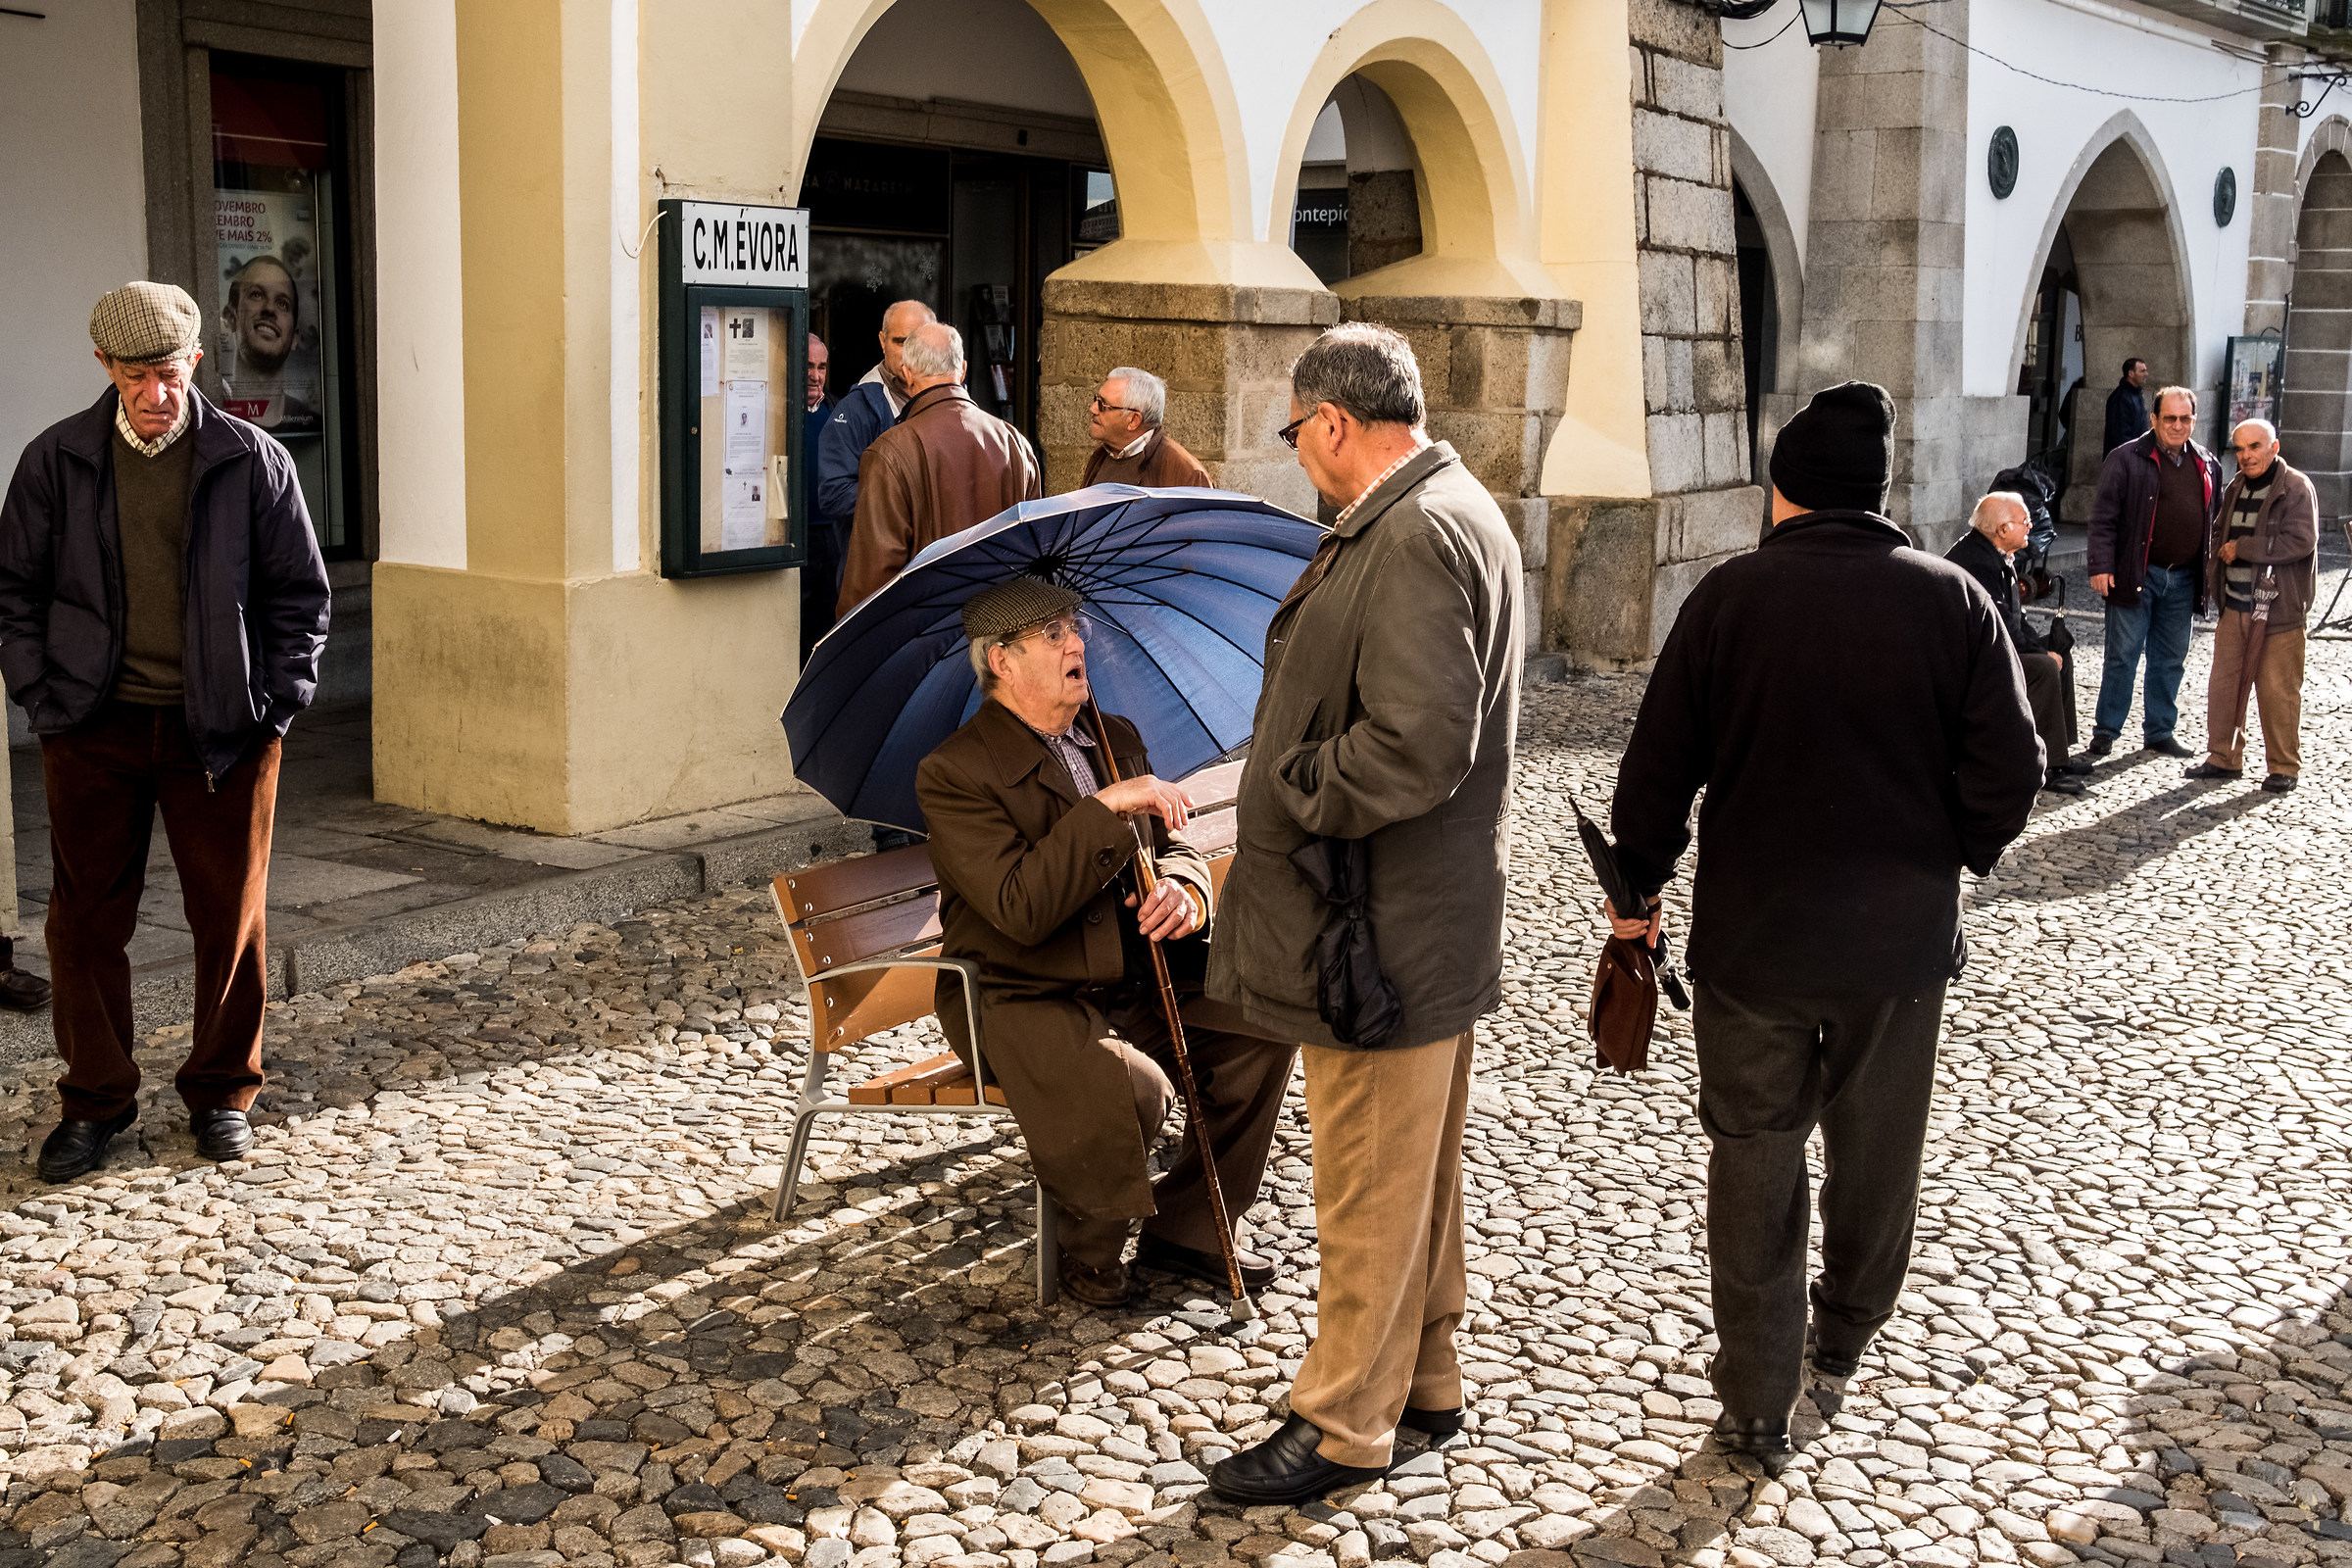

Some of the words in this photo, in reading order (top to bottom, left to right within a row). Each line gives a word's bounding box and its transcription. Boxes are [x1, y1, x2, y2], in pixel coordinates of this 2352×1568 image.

[843, 176, 913, 196] NAZARETH
[227, 229, 254, 242] MAIS
[256, 230, 272, 243] 2%
